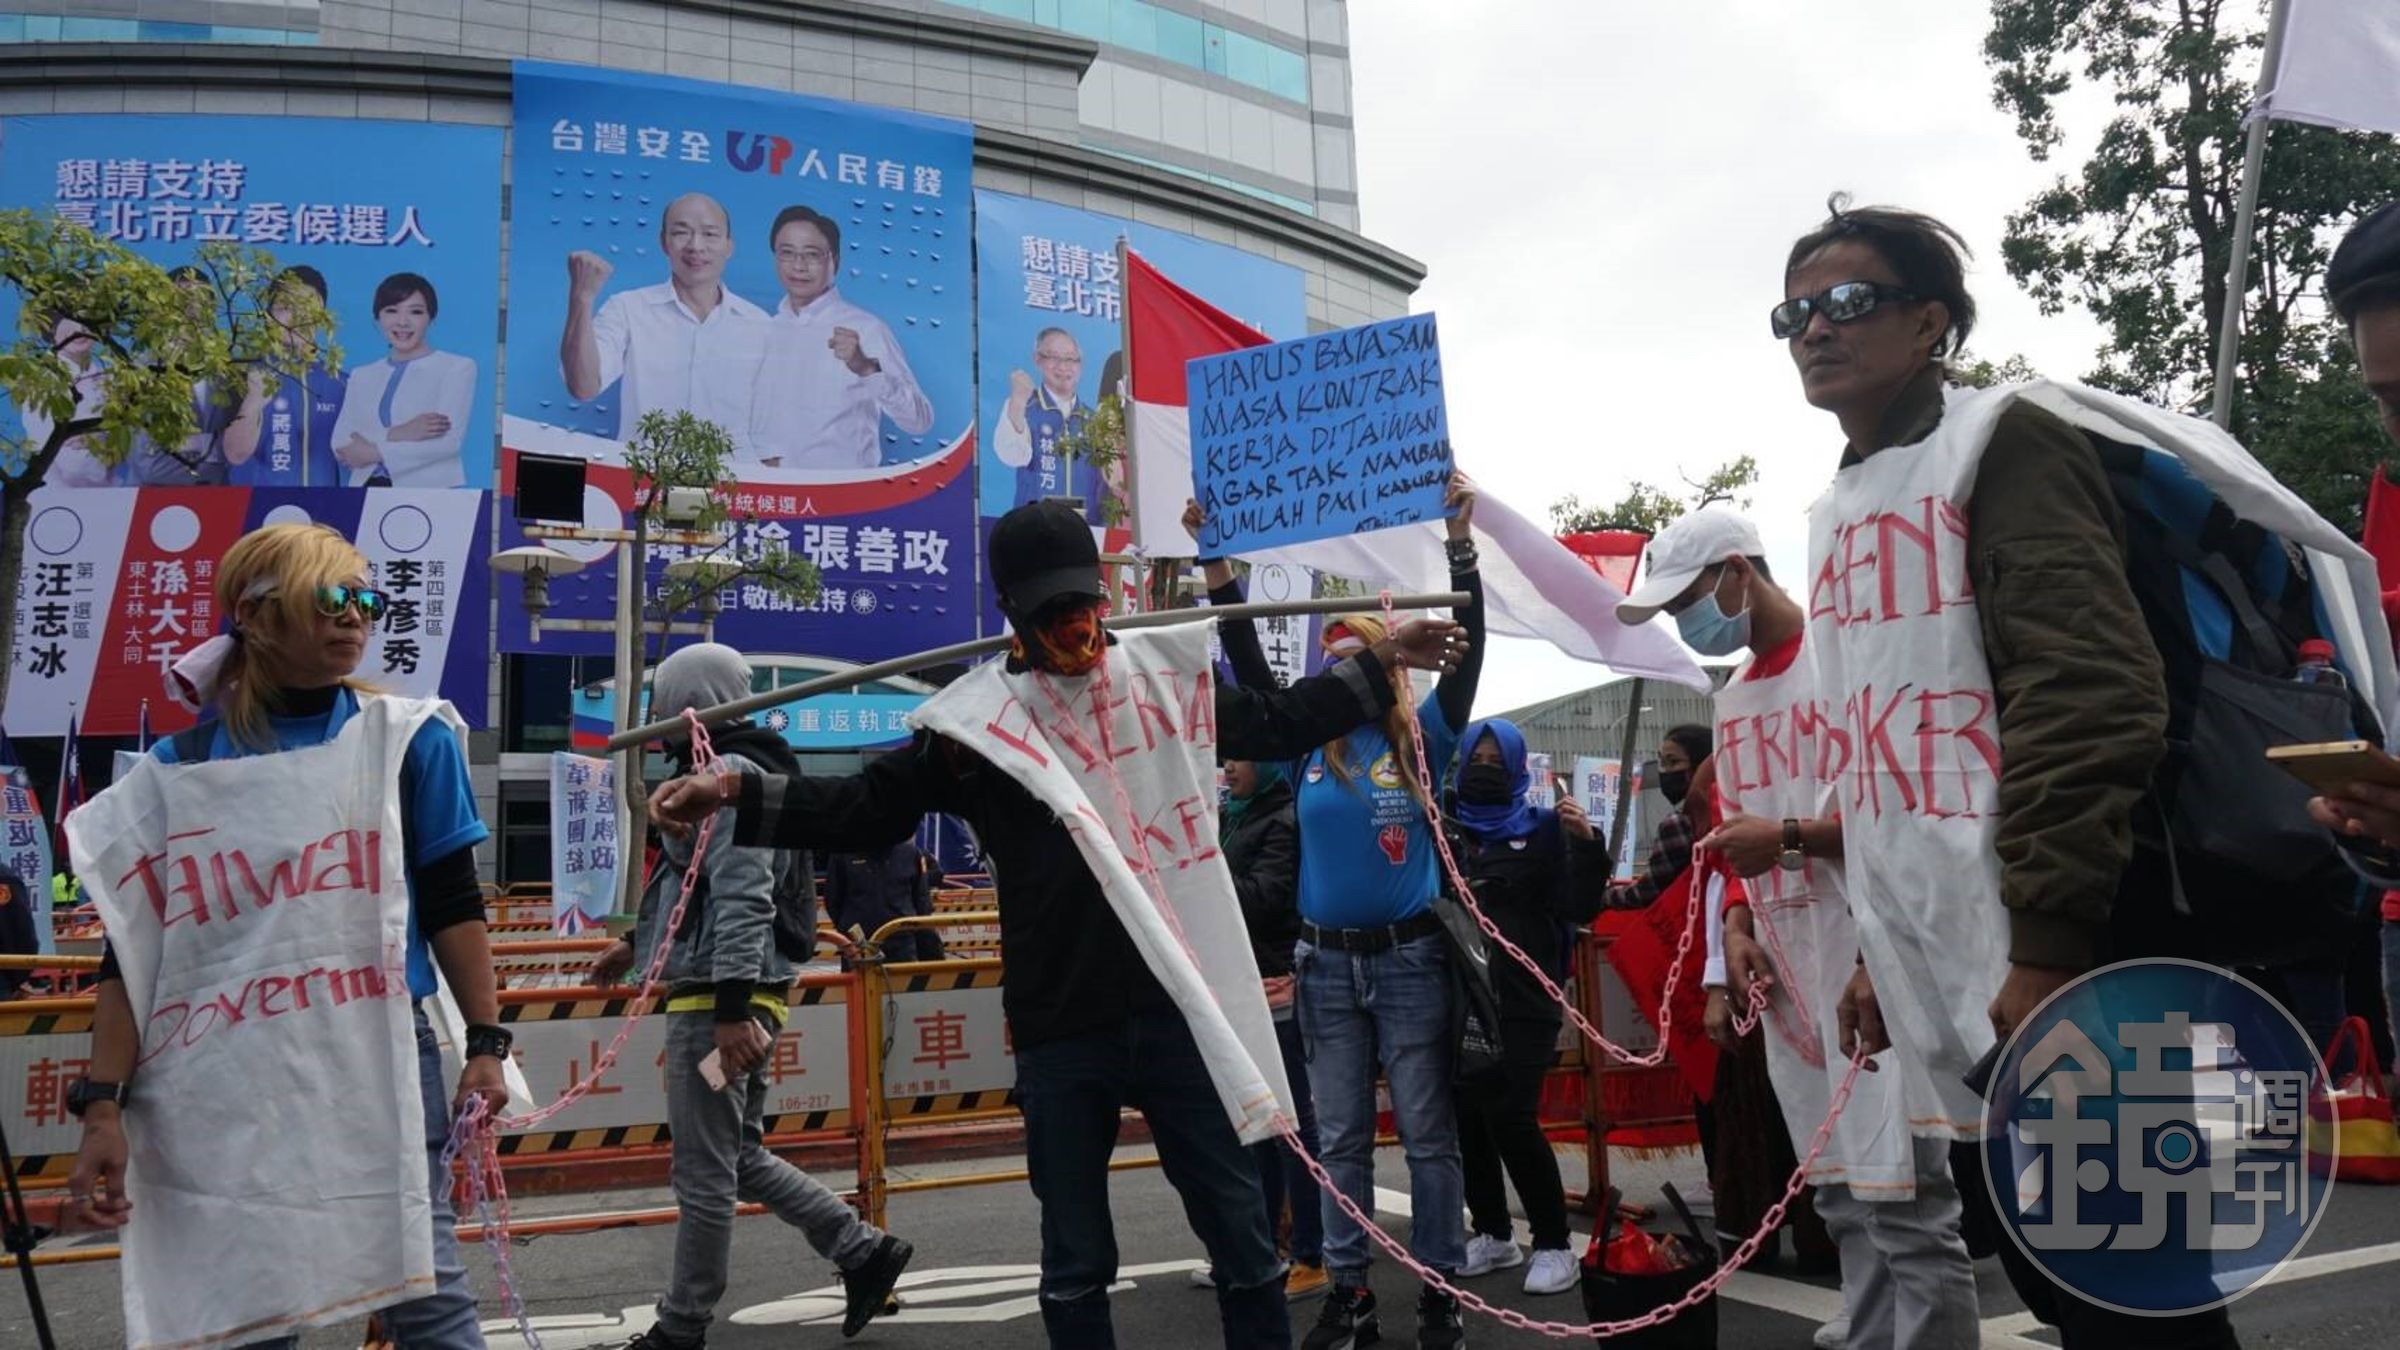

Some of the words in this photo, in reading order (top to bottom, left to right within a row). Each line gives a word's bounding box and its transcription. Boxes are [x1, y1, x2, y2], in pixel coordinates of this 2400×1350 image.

[55, 158, 246, 200] 懇請支持
[552, 118, 711, 164] 台灣安全
[799, 148, 942, 198] 人民有錢
[54, 200, 433, 246] 臺北市立委候選人
[1022, 236, 1120, 285] 懇請支
[1024, 271, 1121, 322] 臺北市
[1203, 343, 1304, 399] HAPUS
[1315, 323, 1437, 372] BATASAN
[1201, 391, 1288, 440] MASA
[1296, 358, 1440, 422] KONTRAK
[1206, 432, 1298, 479] KERJA
[1205, 474, 1284, 515] AGAR
[1287, 457, 1348, 492] TAK
[1205, 498, 1304, 548] JUMLAH
[803, 524, 950, 575] 張善政
[28, 561, 73, 679] 汪志冰
[147, 559, 190, 676] 孫大千
[382, 559, 423, 674] 李彥秀
[797, 708, 912, 732] 重返執政
